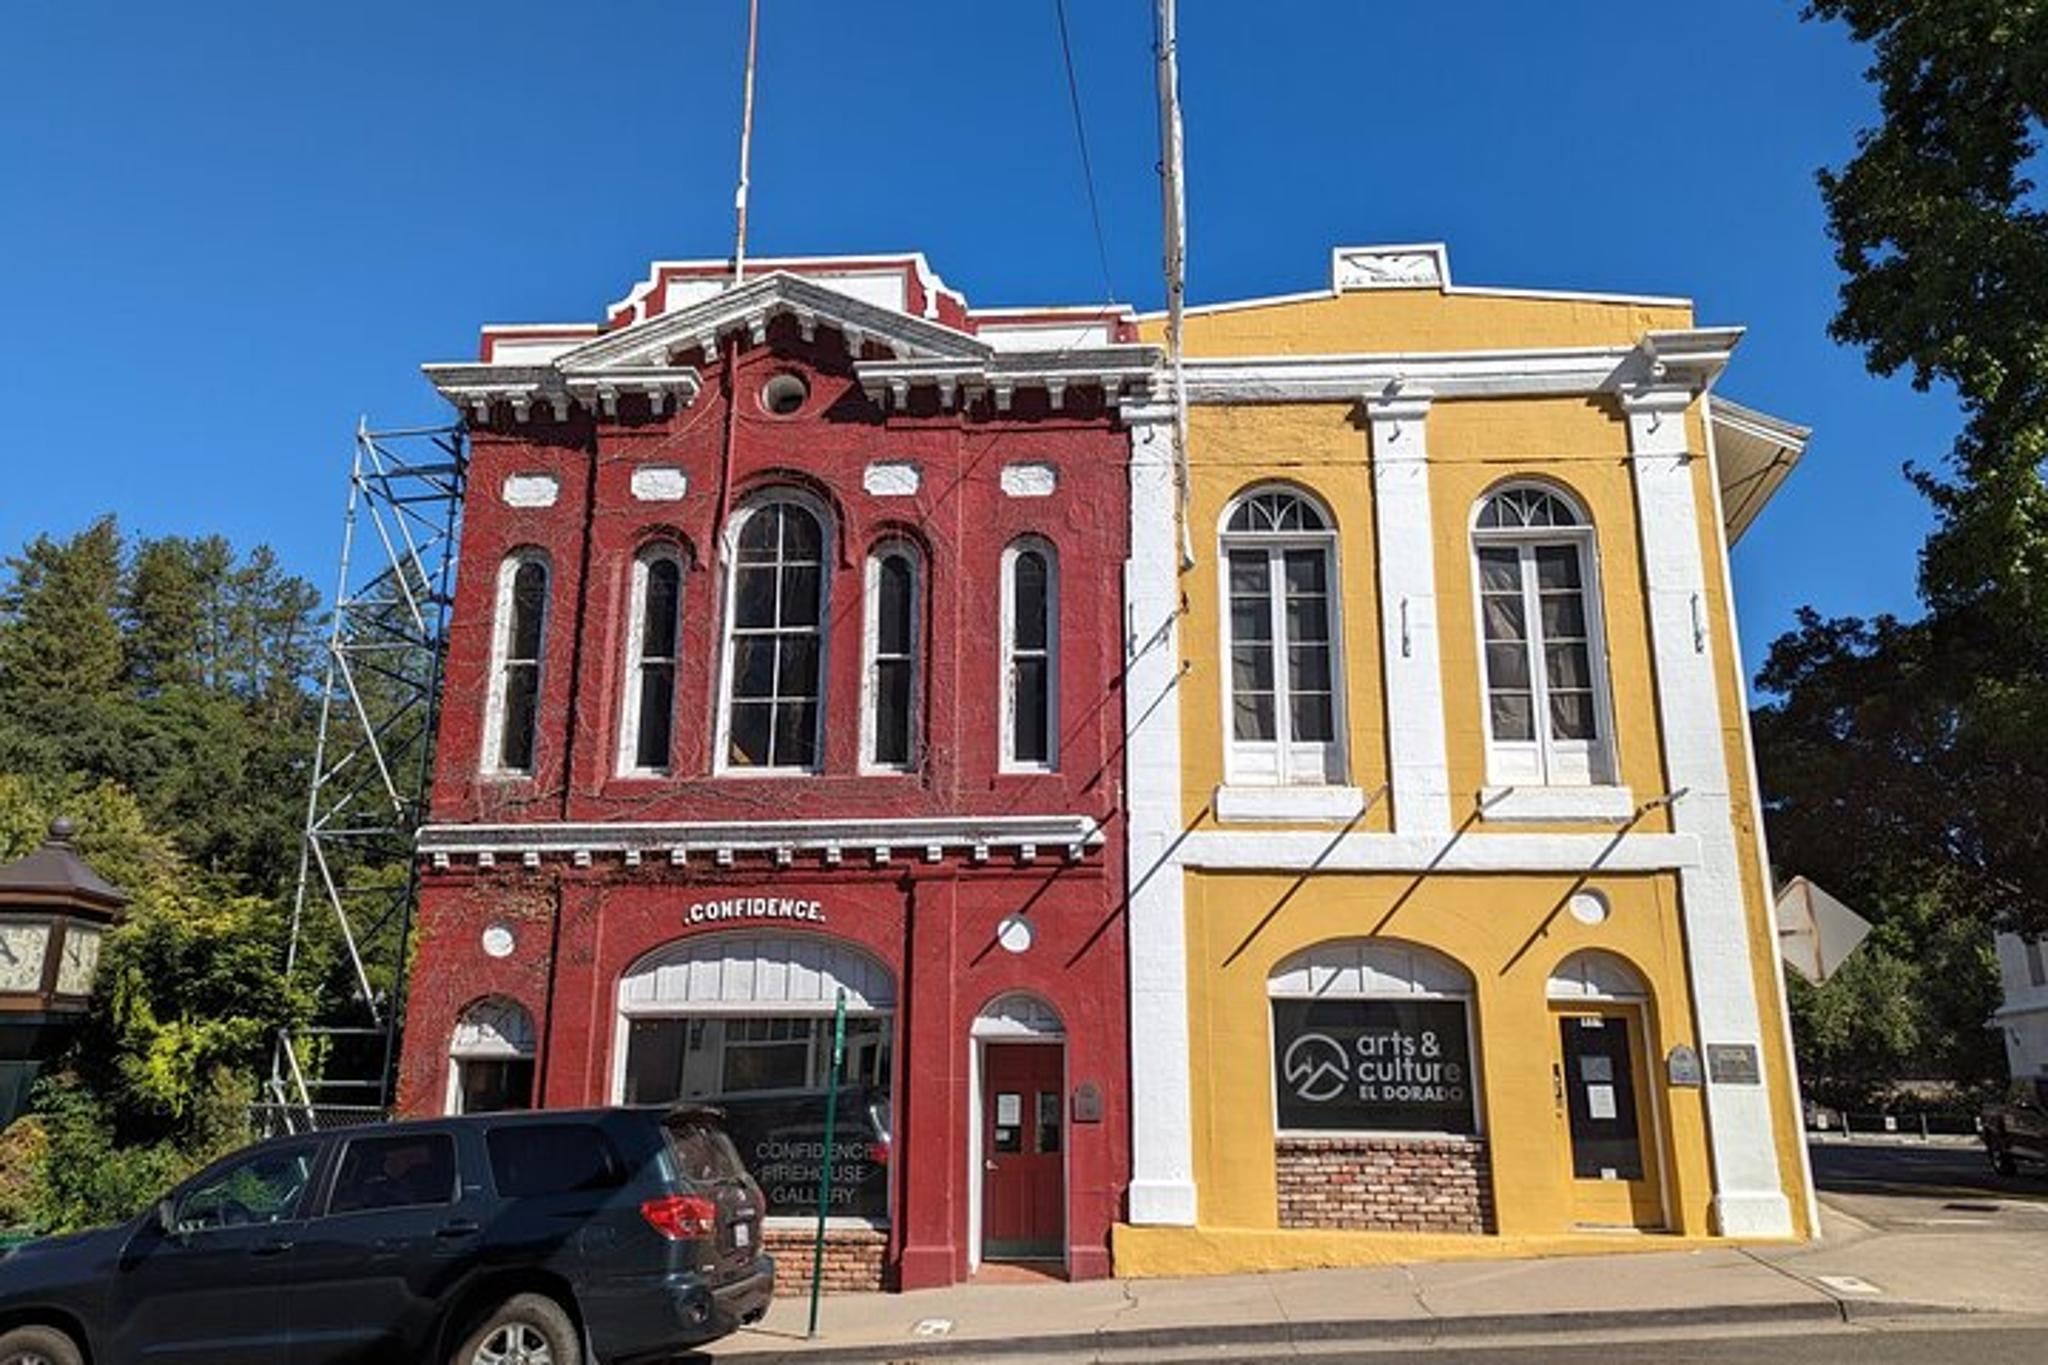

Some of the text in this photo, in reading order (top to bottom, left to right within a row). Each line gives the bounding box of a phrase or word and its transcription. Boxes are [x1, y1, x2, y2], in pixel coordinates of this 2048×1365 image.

[1357, 1031, 1442, 1057] arts &
[1358, 1057, 1461, 1082] culture
[1360, 1085, 1463, 1101] EL DORADO
[771, 1185, 856, 1203] GALLRY
